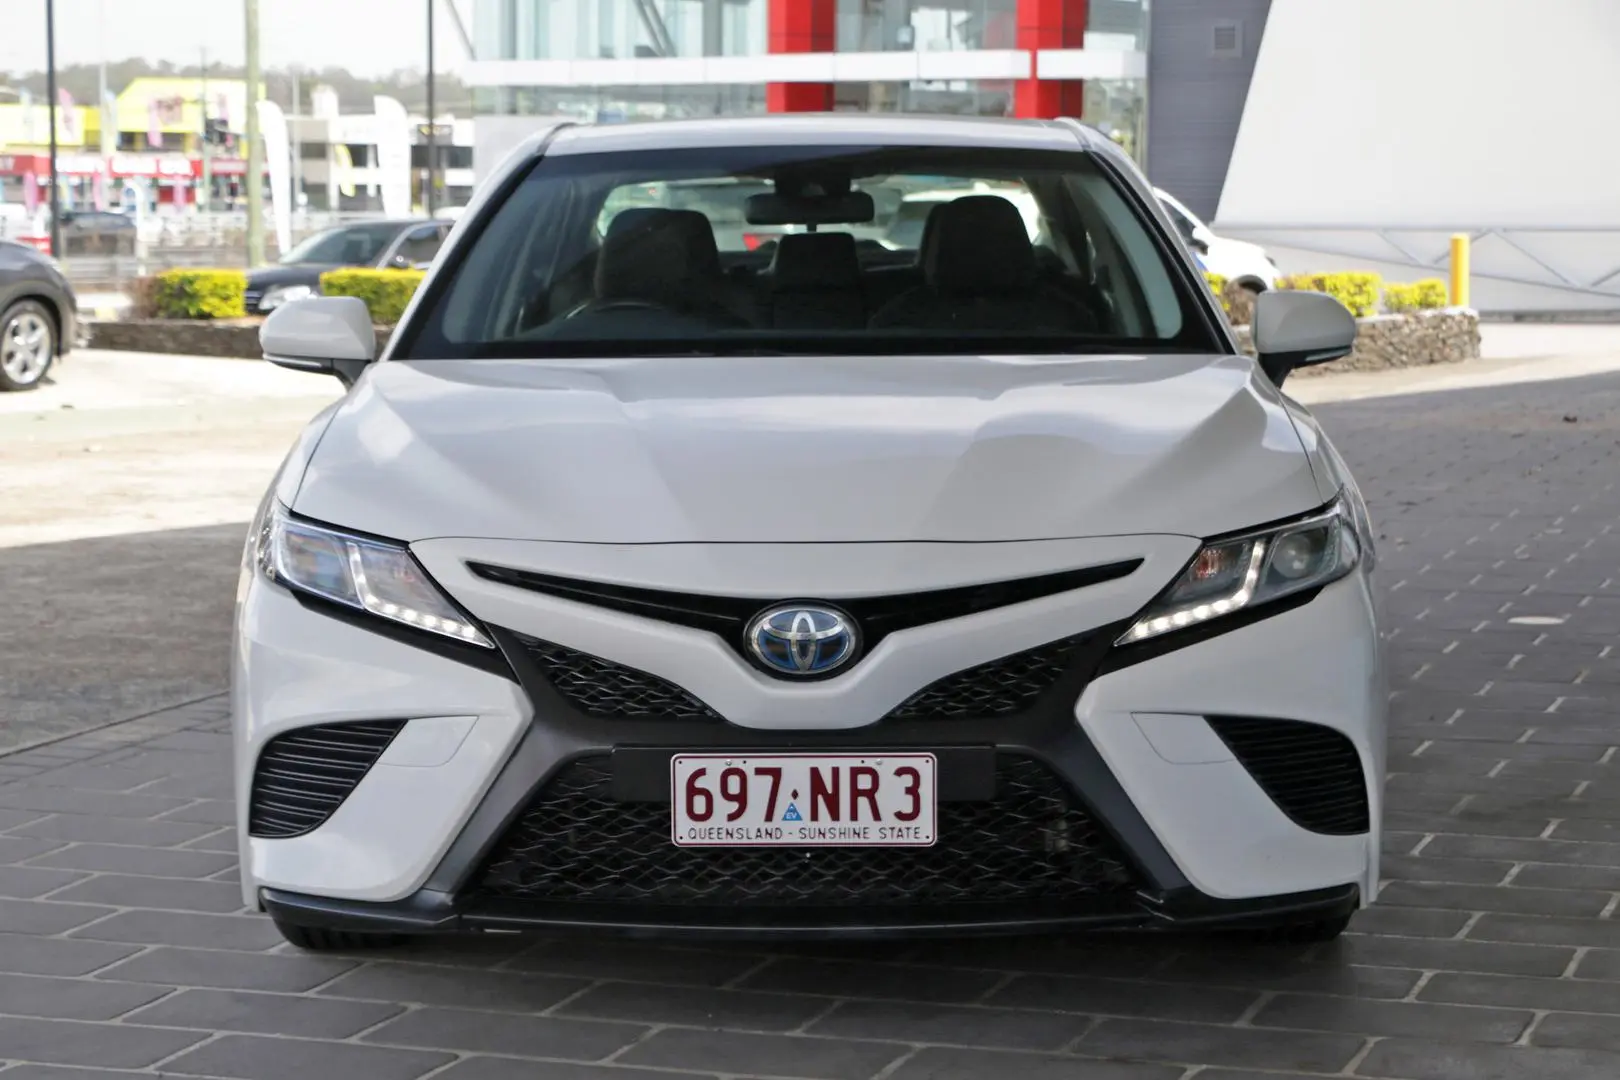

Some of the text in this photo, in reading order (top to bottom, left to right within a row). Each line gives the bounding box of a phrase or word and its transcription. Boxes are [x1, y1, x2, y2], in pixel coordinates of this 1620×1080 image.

[688, 827, 783, 840] QUEENSLAND
[799, 827, 870, 839] SUNSHINE
[879, 827, 921, 839] STATE
